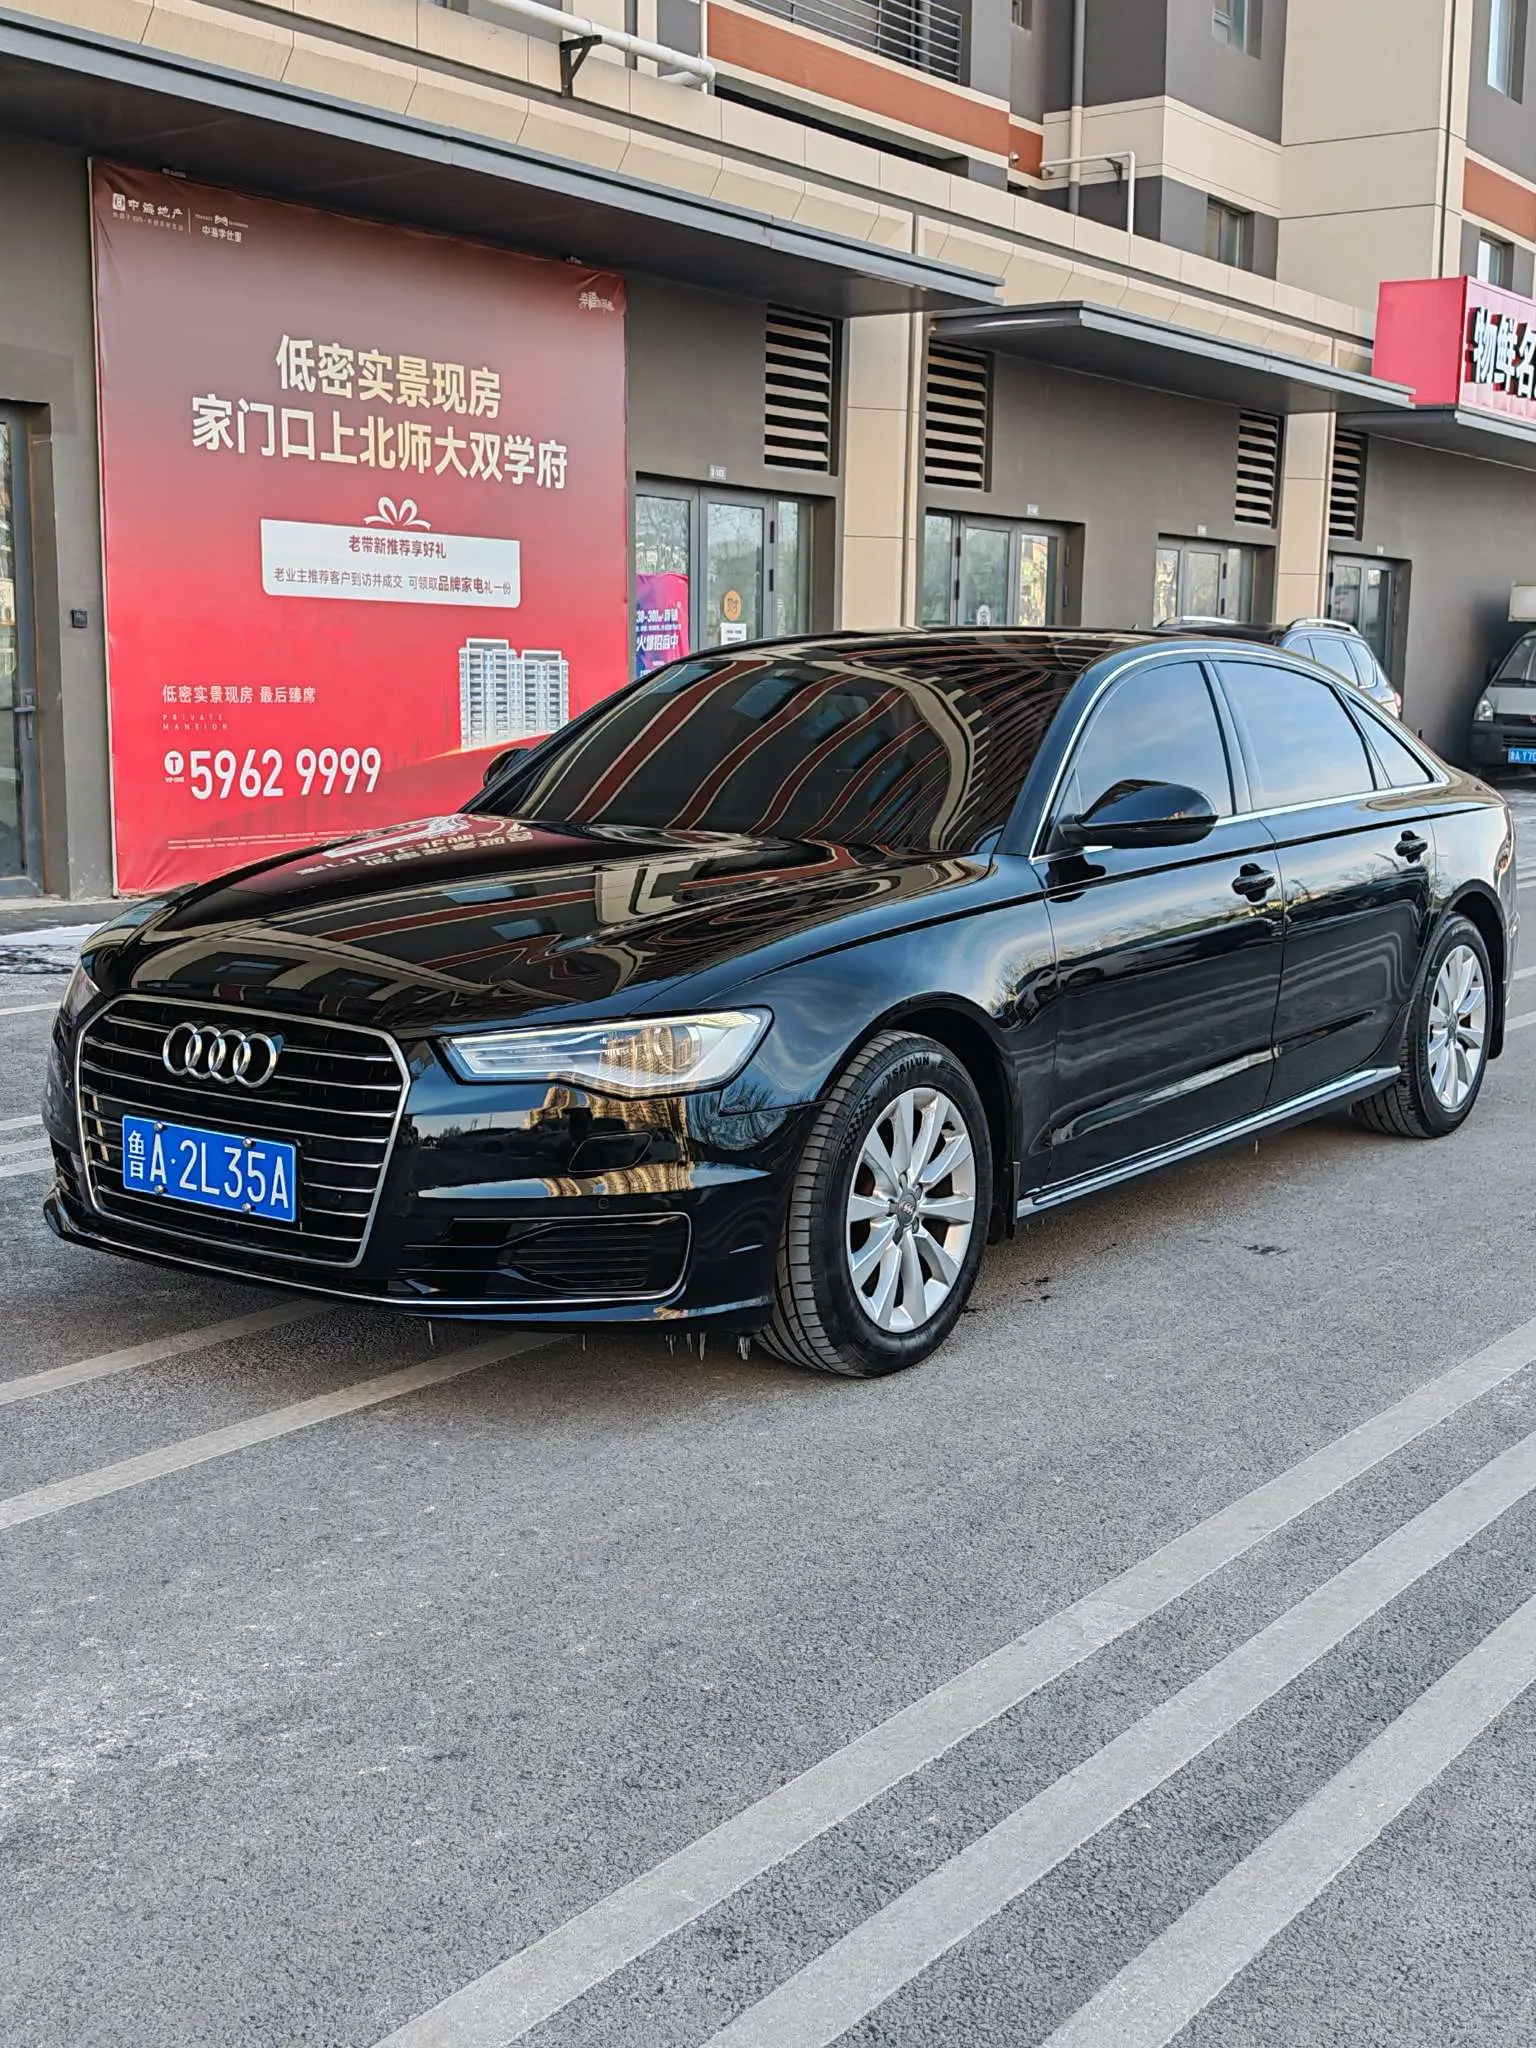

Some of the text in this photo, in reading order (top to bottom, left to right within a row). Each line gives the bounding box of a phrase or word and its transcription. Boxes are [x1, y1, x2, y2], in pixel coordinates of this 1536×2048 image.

[275, 334, 501, 419] 低密实景现房
[1472, 305, 1536, 400] 物鲜名
[192, 393, 568, 490] 家门口上北师大双学府
[348, 535, 447, 559] 老带新推荐享好礼
[162, 685, 253, 704] 低密实景现房
[162, 713, 224, 721] PRIVATE
[162, 723, 228, 731] MANSION
[190, 747, 381, 800] 5962 9999
[127, 1130, 289, 1209] 鲁A·2L35A
